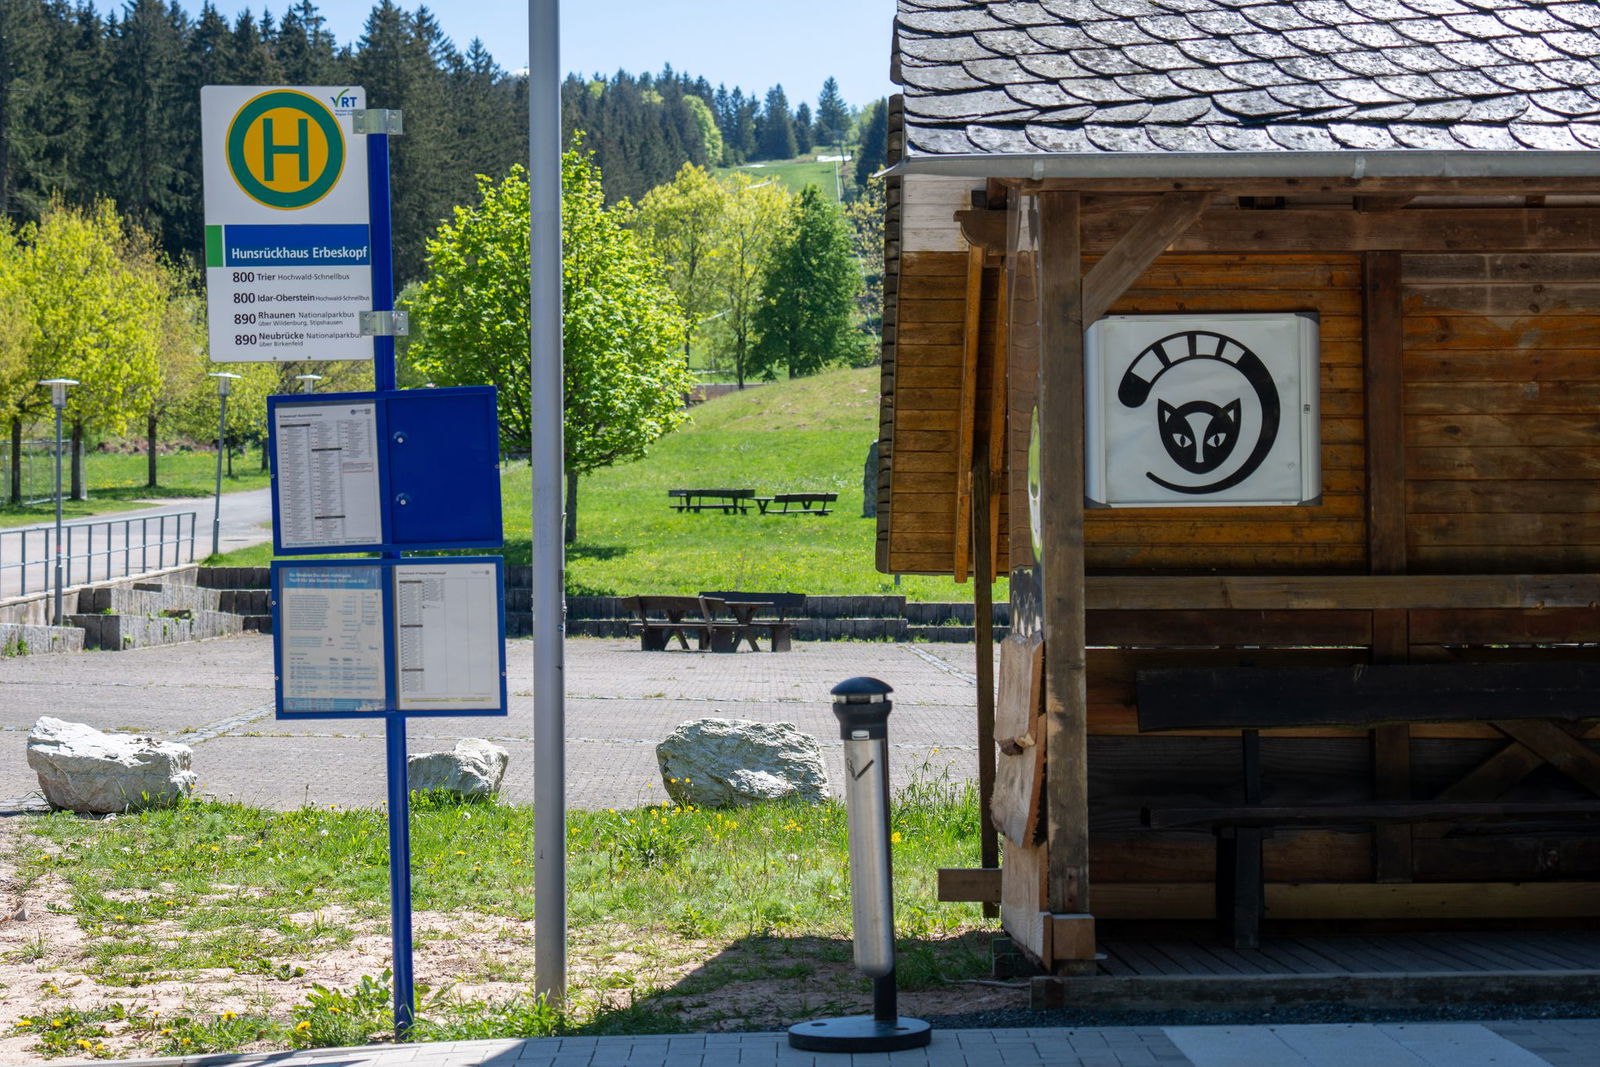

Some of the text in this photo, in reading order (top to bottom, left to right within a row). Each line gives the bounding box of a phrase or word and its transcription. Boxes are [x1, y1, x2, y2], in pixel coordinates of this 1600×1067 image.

[330, 88, 357, 108] VRT
[262, 118, 309, 181] H
[231, 247, 367, 260] Hunsrückhaus Erbeskopf
[233, 272, 350, 283] 800 Trier Hochwald-Schnellbus
[233, 292, 370, 304] 800 Idar-Oberstein Hochwald-Schnellbus
[234, 311, 355, 325] 890 Rhaunen Nationalparkbus
[234, 334, 257, 346] 890
[258, 331, 304, 341] Neubrücke
